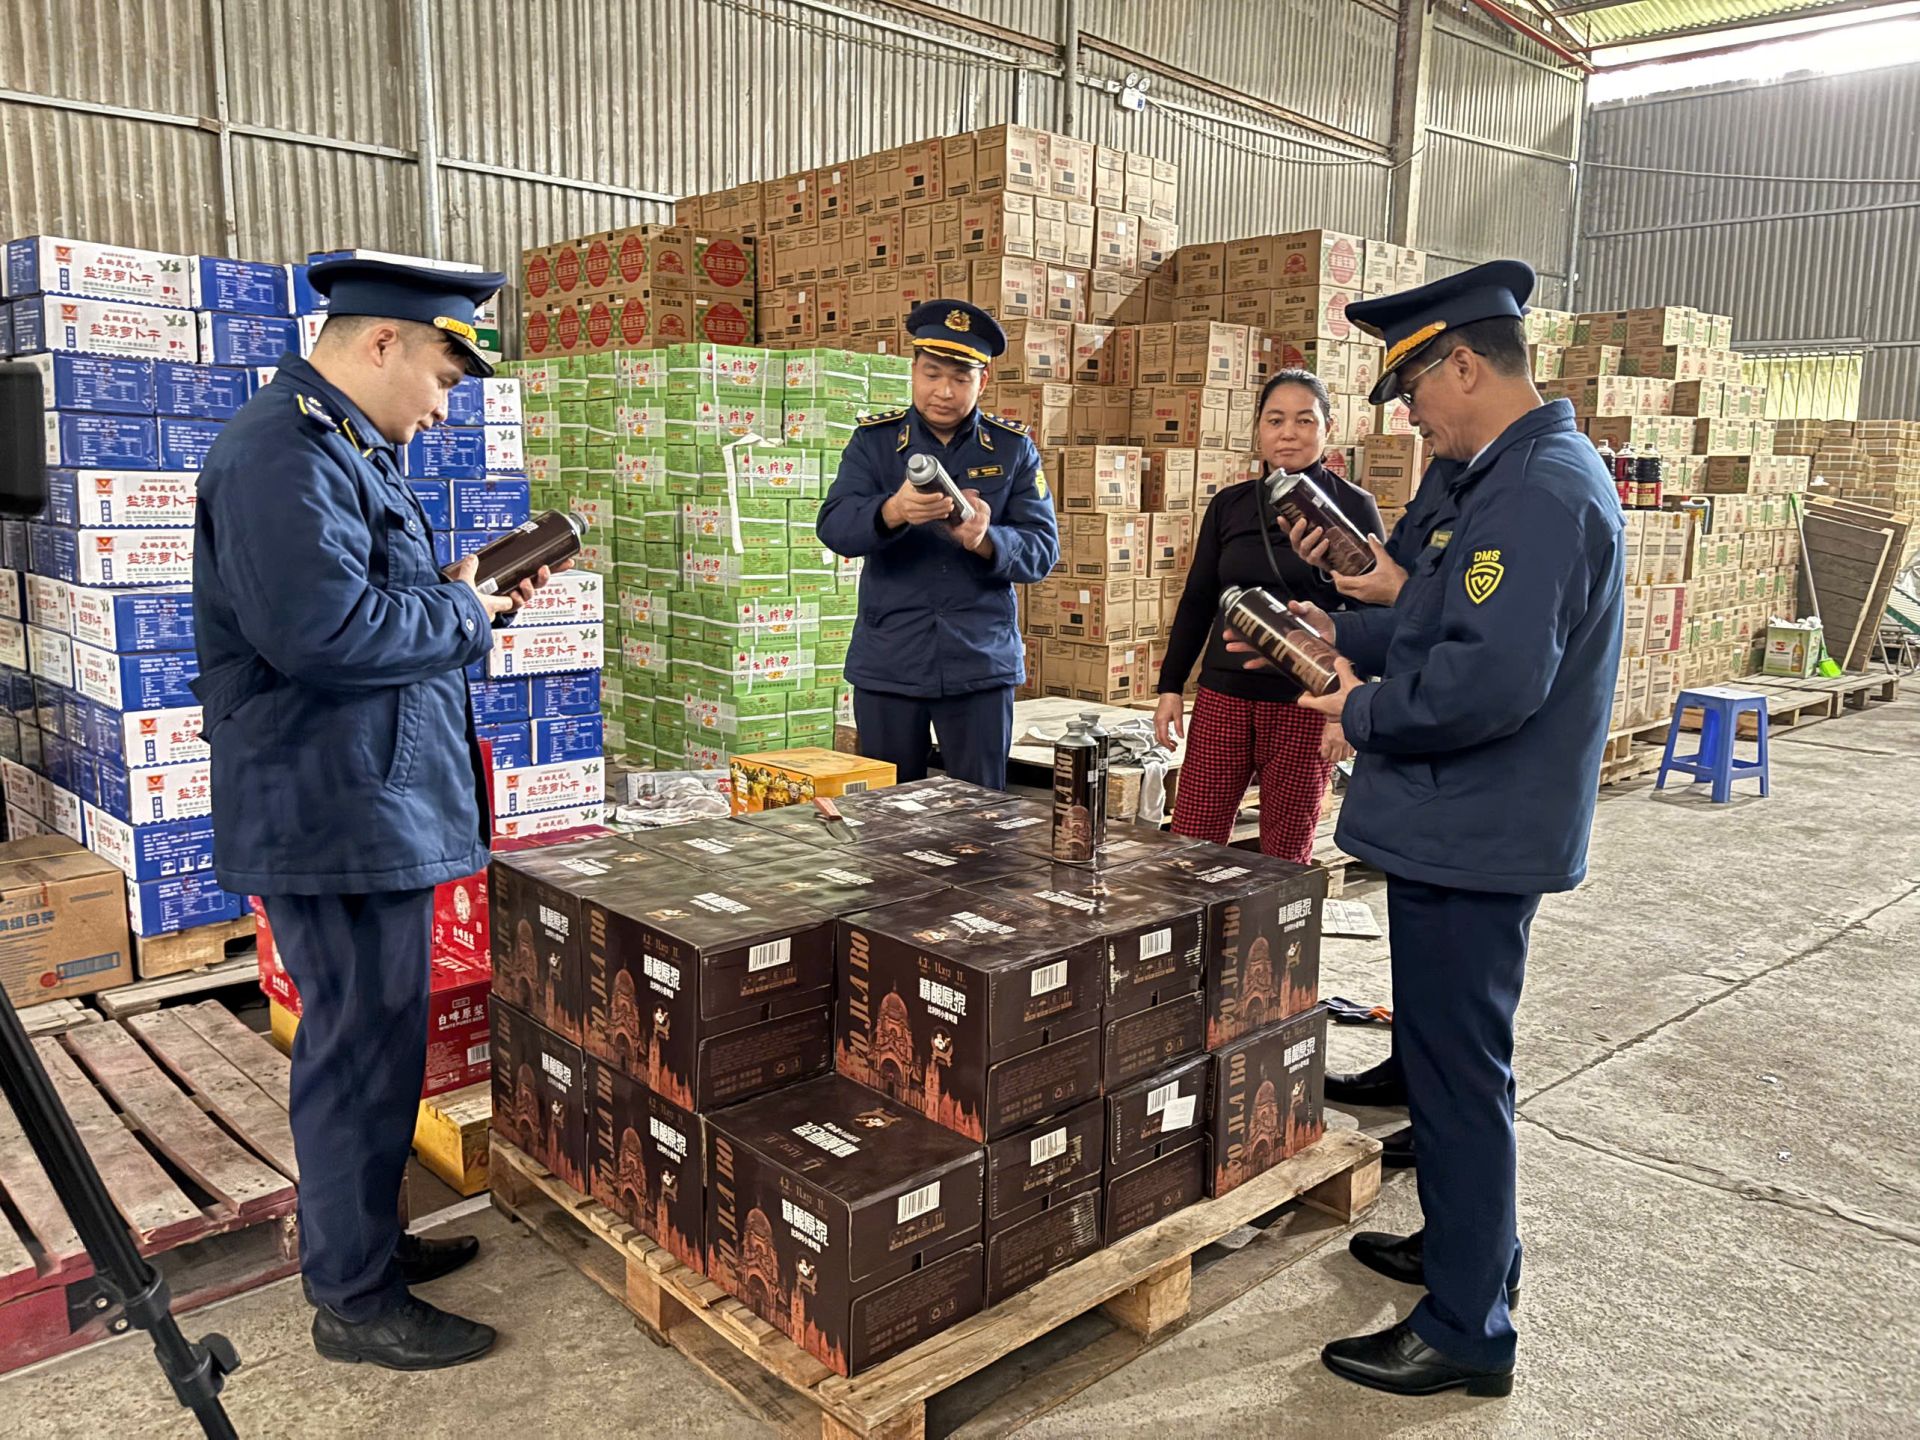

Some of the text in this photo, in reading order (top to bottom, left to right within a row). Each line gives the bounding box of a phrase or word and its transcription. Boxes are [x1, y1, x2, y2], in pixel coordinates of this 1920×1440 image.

[1474, 549, 1501, 562] DMS
[1056, 752, 1073, 779] BO
[590, 909, 608, 949] BO
[1223, 905, 1241, 938] BO
[850, 931, 870, 972] BO
[438, 1004, 484, 1026] 白啤原浆
[598, 1065, 613, 1105] BO
[1230, 1053, 1247, 1087] BO
[716, 1137, 735, 1183] BO
